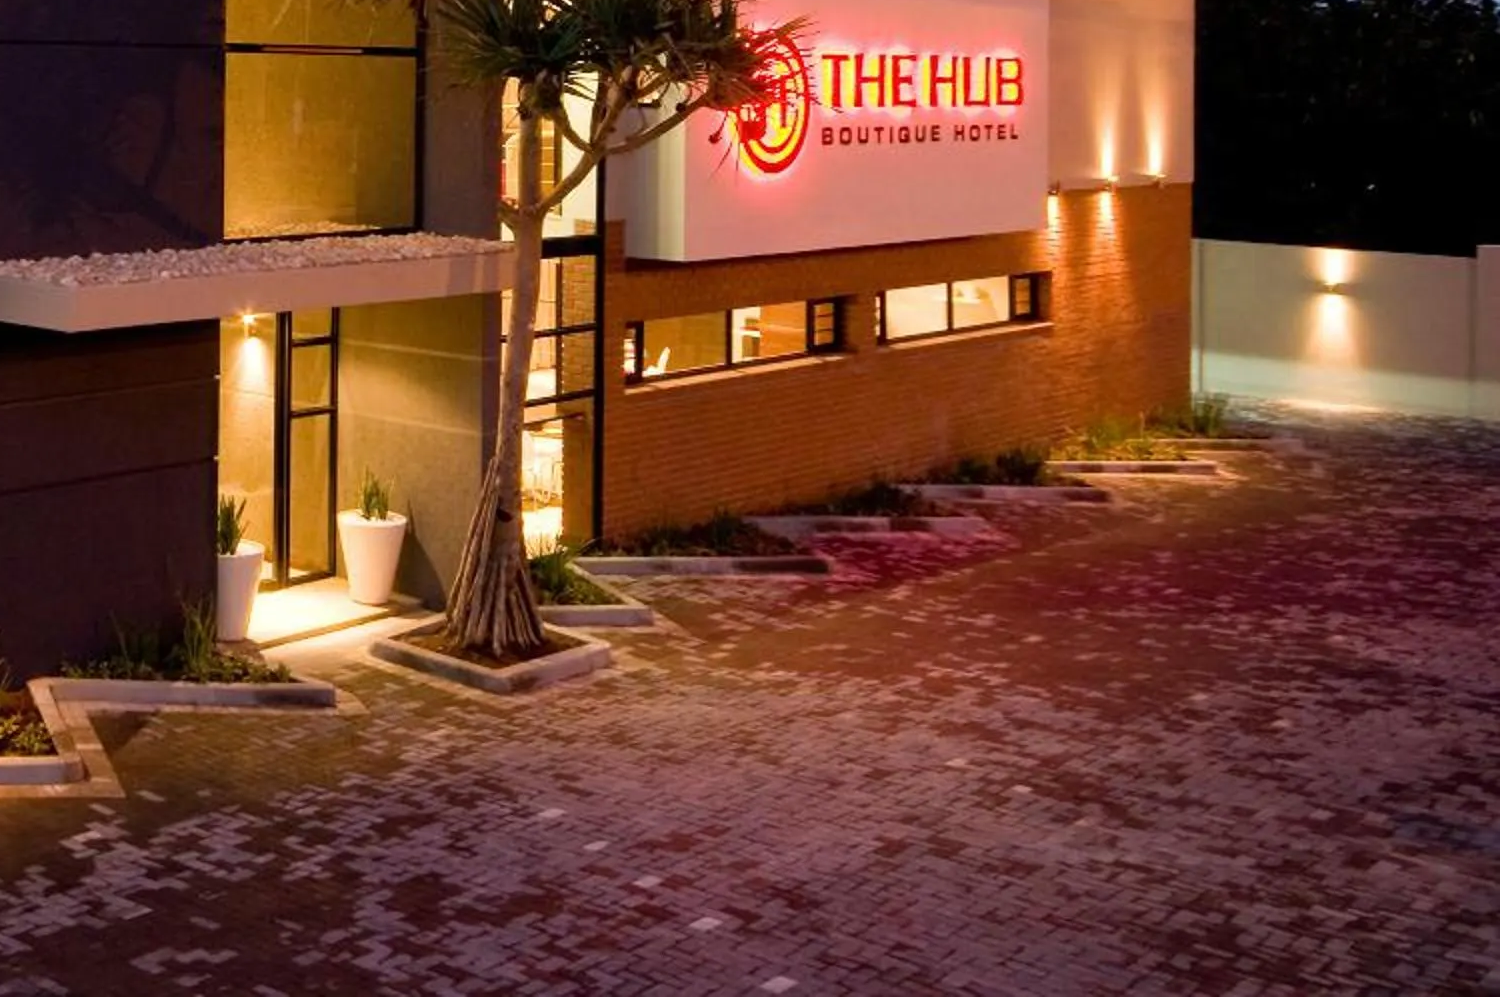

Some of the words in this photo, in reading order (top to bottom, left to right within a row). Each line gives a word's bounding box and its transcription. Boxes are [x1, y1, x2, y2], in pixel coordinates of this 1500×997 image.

[821, 53, 917, 108] THE
[929, 55, 1024, 107] HUB
[821, 124, 941, 146] BOUTIQUE
[953, 123, 1020, 142] HOTEL
